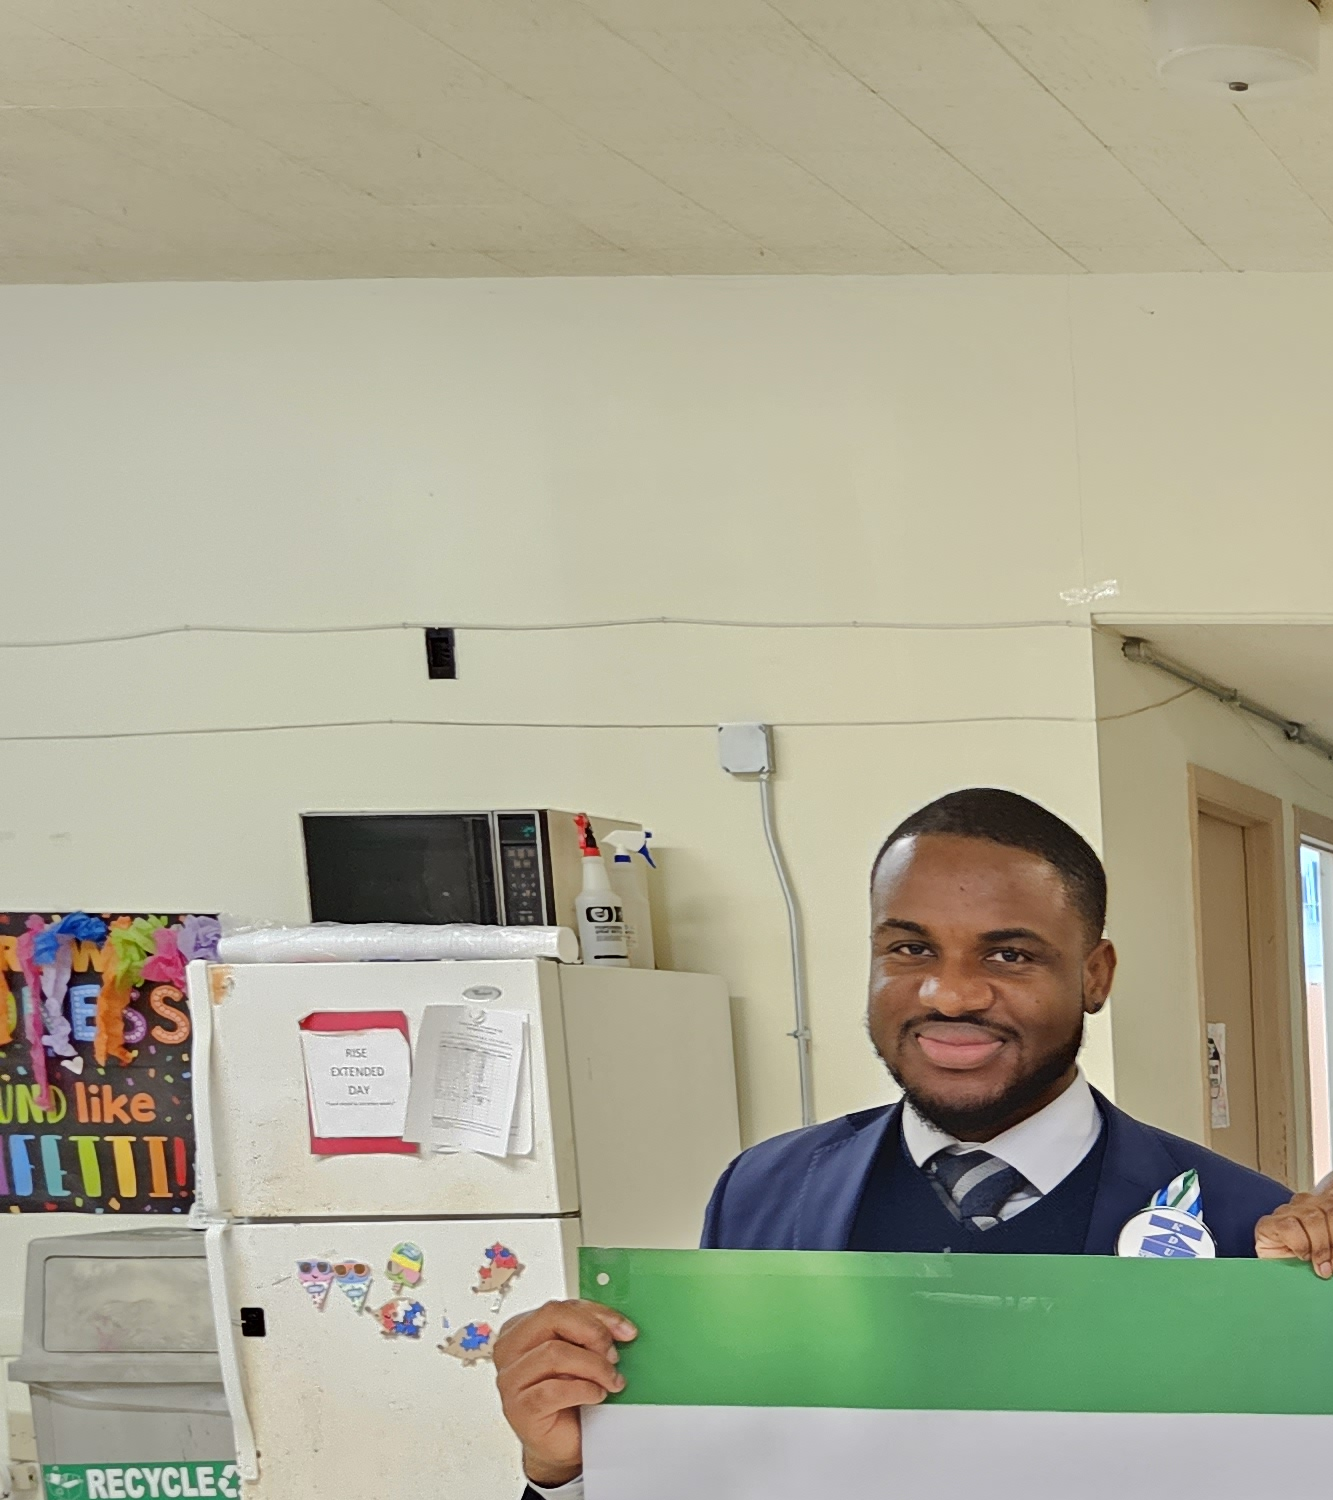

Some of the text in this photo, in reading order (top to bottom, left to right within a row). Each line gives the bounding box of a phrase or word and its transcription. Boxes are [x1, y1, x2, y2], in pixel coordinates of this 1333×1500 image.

[345, 1048, 367, 1058] RISE
[330, 1066, 385, 1077] EXTENDED
[348, 1085, 370, 1095] DAY
[74, 1081, 157, 1125] like
[1171, 1222, 1184, 1232] K
[1168, 1236, 1179, 1245] D
[1163, 1248, 1175, 1257] U
[86, 1466, 217, 1500] RECYCLE
